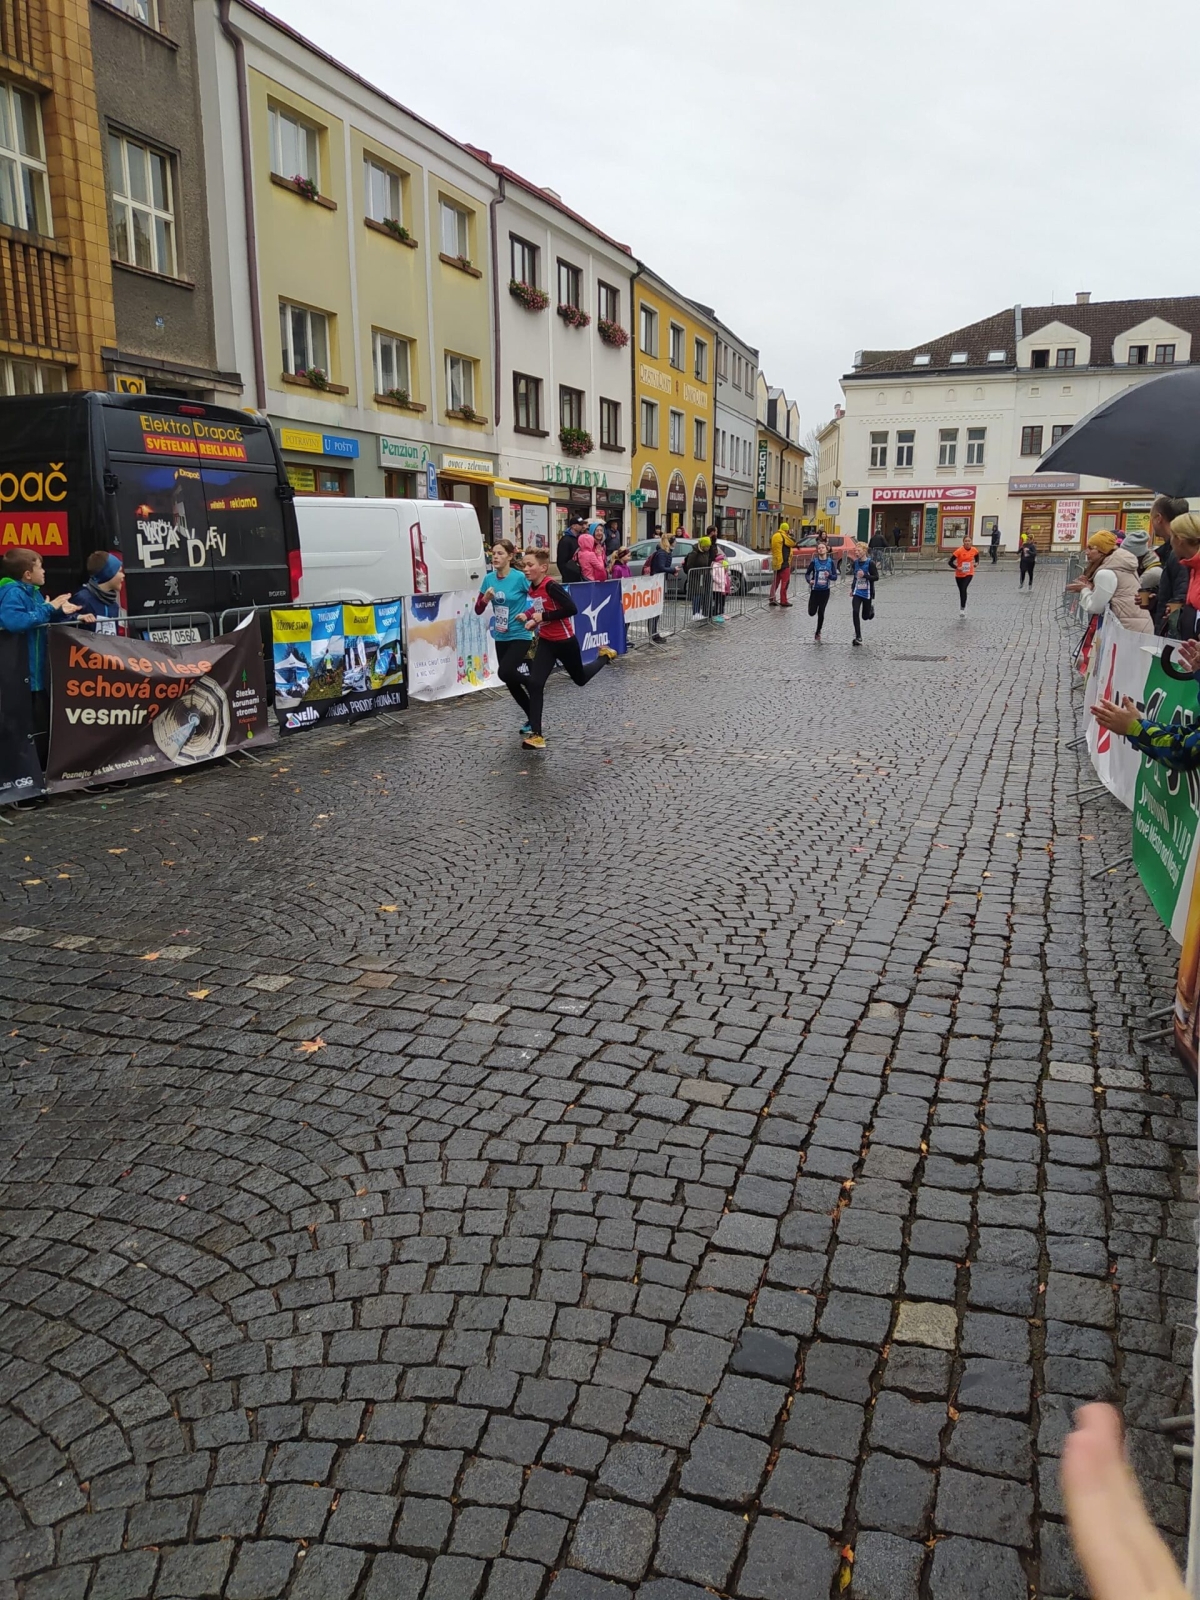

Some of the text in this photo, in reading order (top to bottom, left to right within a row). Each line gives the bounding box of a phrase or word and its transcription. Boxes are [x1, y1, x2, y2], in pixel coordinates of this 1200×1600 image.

[140, 414, 243, 442] Elektro Drapač
[146, 437, 244, 458] SVĚTELNÁ REKLAMA
[285, 434, 319, 448] POTRAVINY
[324, 438, 353, 453] U POŠTY
[382, 438, 419, 459] Penzion
[447, 459, 490, 473] ovoce zelenina
[758, 451, 767, 493] GRYFA
[179, 468, 201, 480] Drapač
[546, 461, 608, 488] LÉKÁRNA
[874, 488, 944, 500] POTRAVINY
[229, 497, 258, 509] reklama
[1, 522, 63, 546] AMA
[414, 601, 437, 609] NATURA
[174, 628, 198, 642] 0562
[69, 645, 212, 675] Kam se v lese
[66, 675, 149, 699] schová
[235, 688, 256, 698] Stezka
[232, 695, 260, 709] korunami
[64, 703, 159, 725] vesmír?
[236, 705, 258, 717] stromů
[62, 771, 92, 779] Poznejte
[102, 764, 115, 773] tak
[115, 758, 140, 770] trochu
[140, 755, 157, 767] jinak
[15, 776, 34, 787] CSG
[1135, 810, 1151, 839] Nové
[1148, 822, 1162, 855] Město
